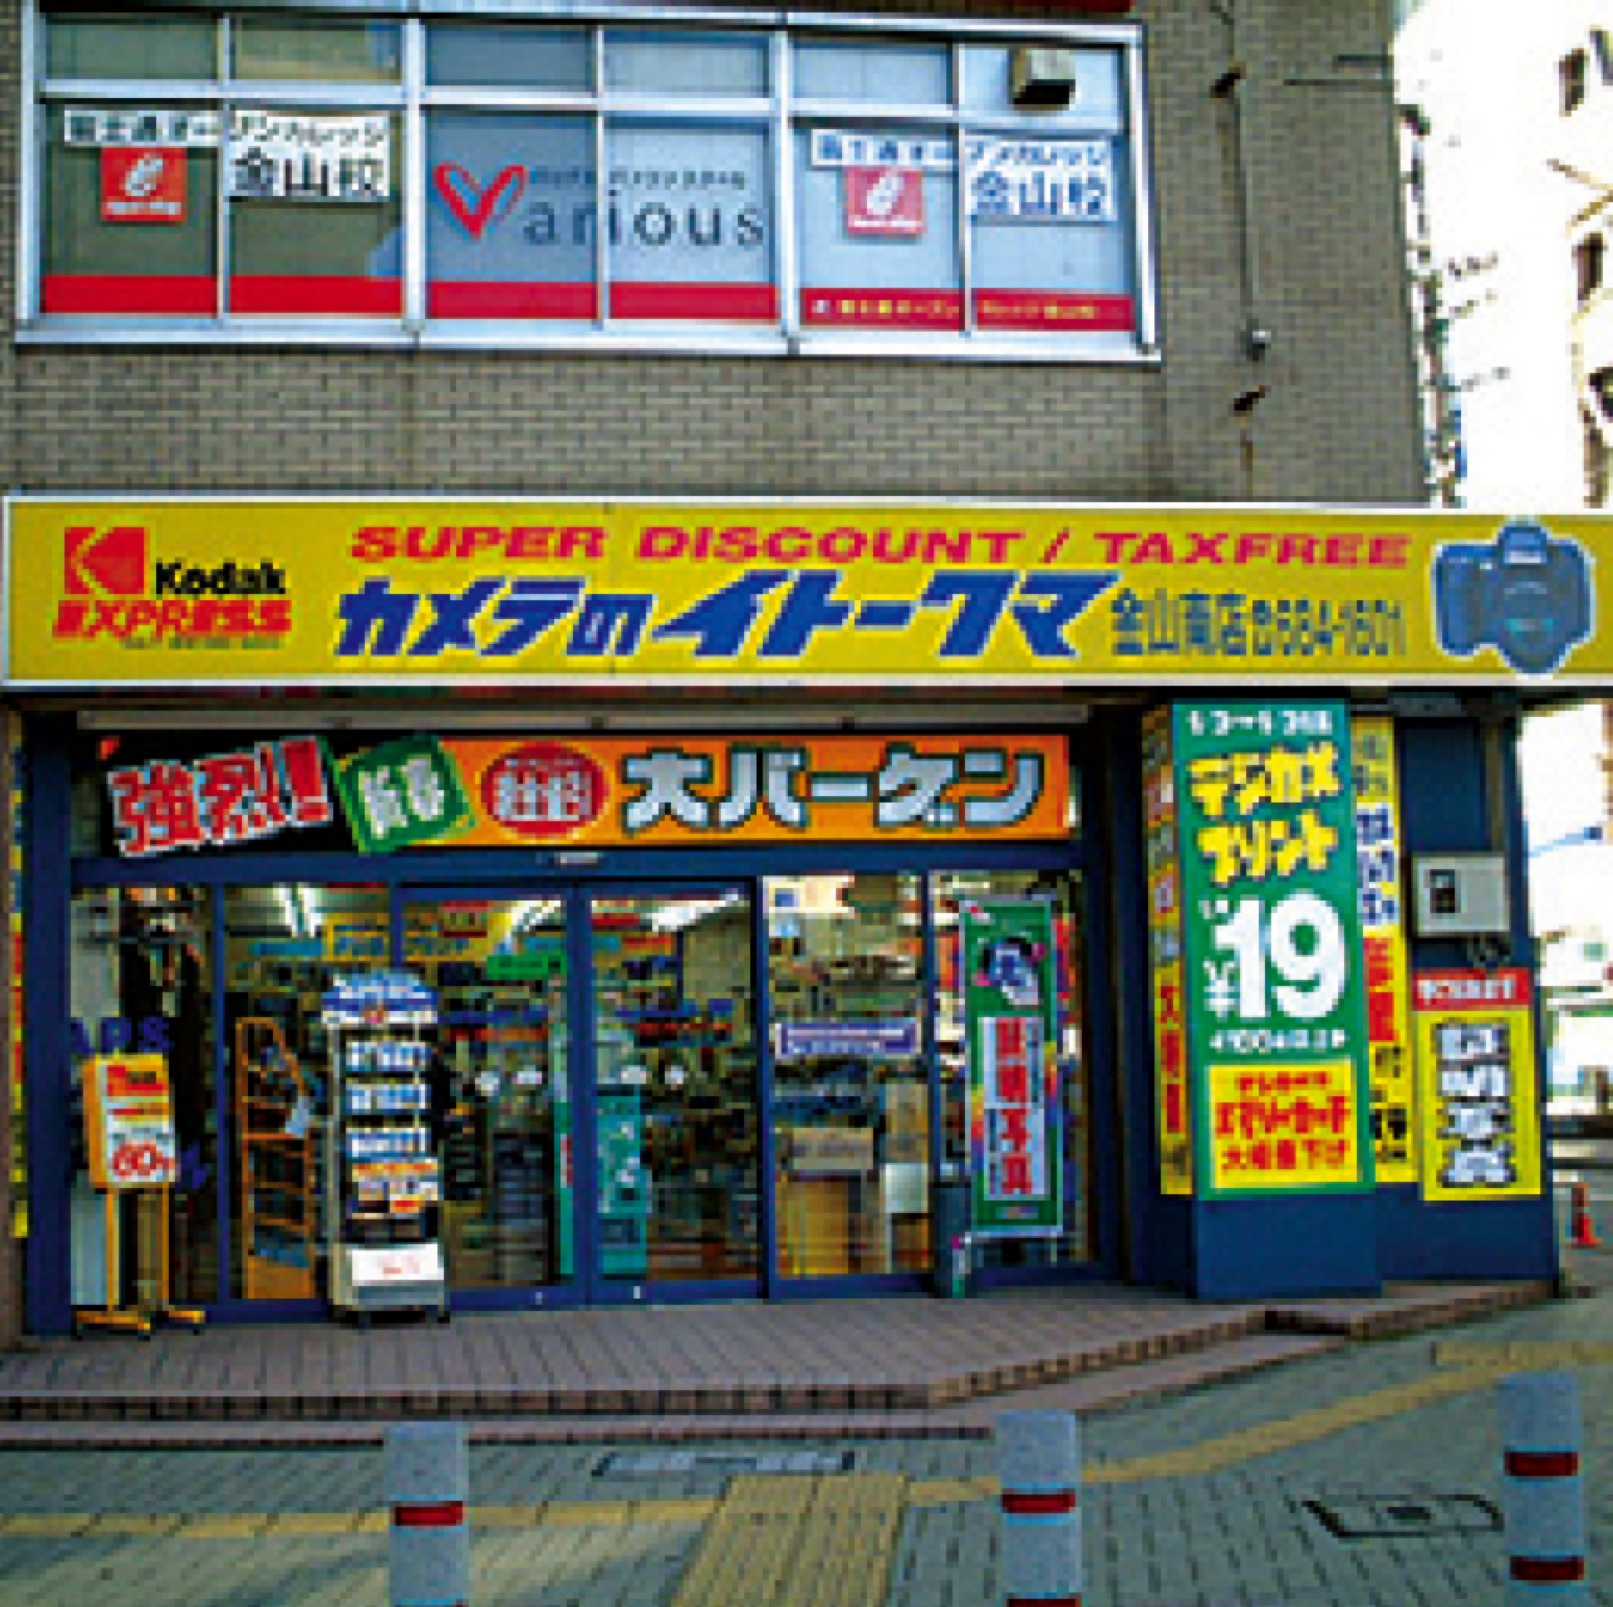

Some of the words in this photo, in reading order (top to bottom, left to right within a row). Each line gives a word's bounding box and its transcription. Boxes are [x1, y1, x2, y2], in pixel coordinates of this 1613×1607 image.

[350, 526, 605, 562] SUPER
[638, 527, 1024, 564] DISCOUNT
[1093, 532, 1410, 568] TAXFREE
[155, 560, 287, 596] Kodak
[622, 744, 1045, 833] 大バーゲン
